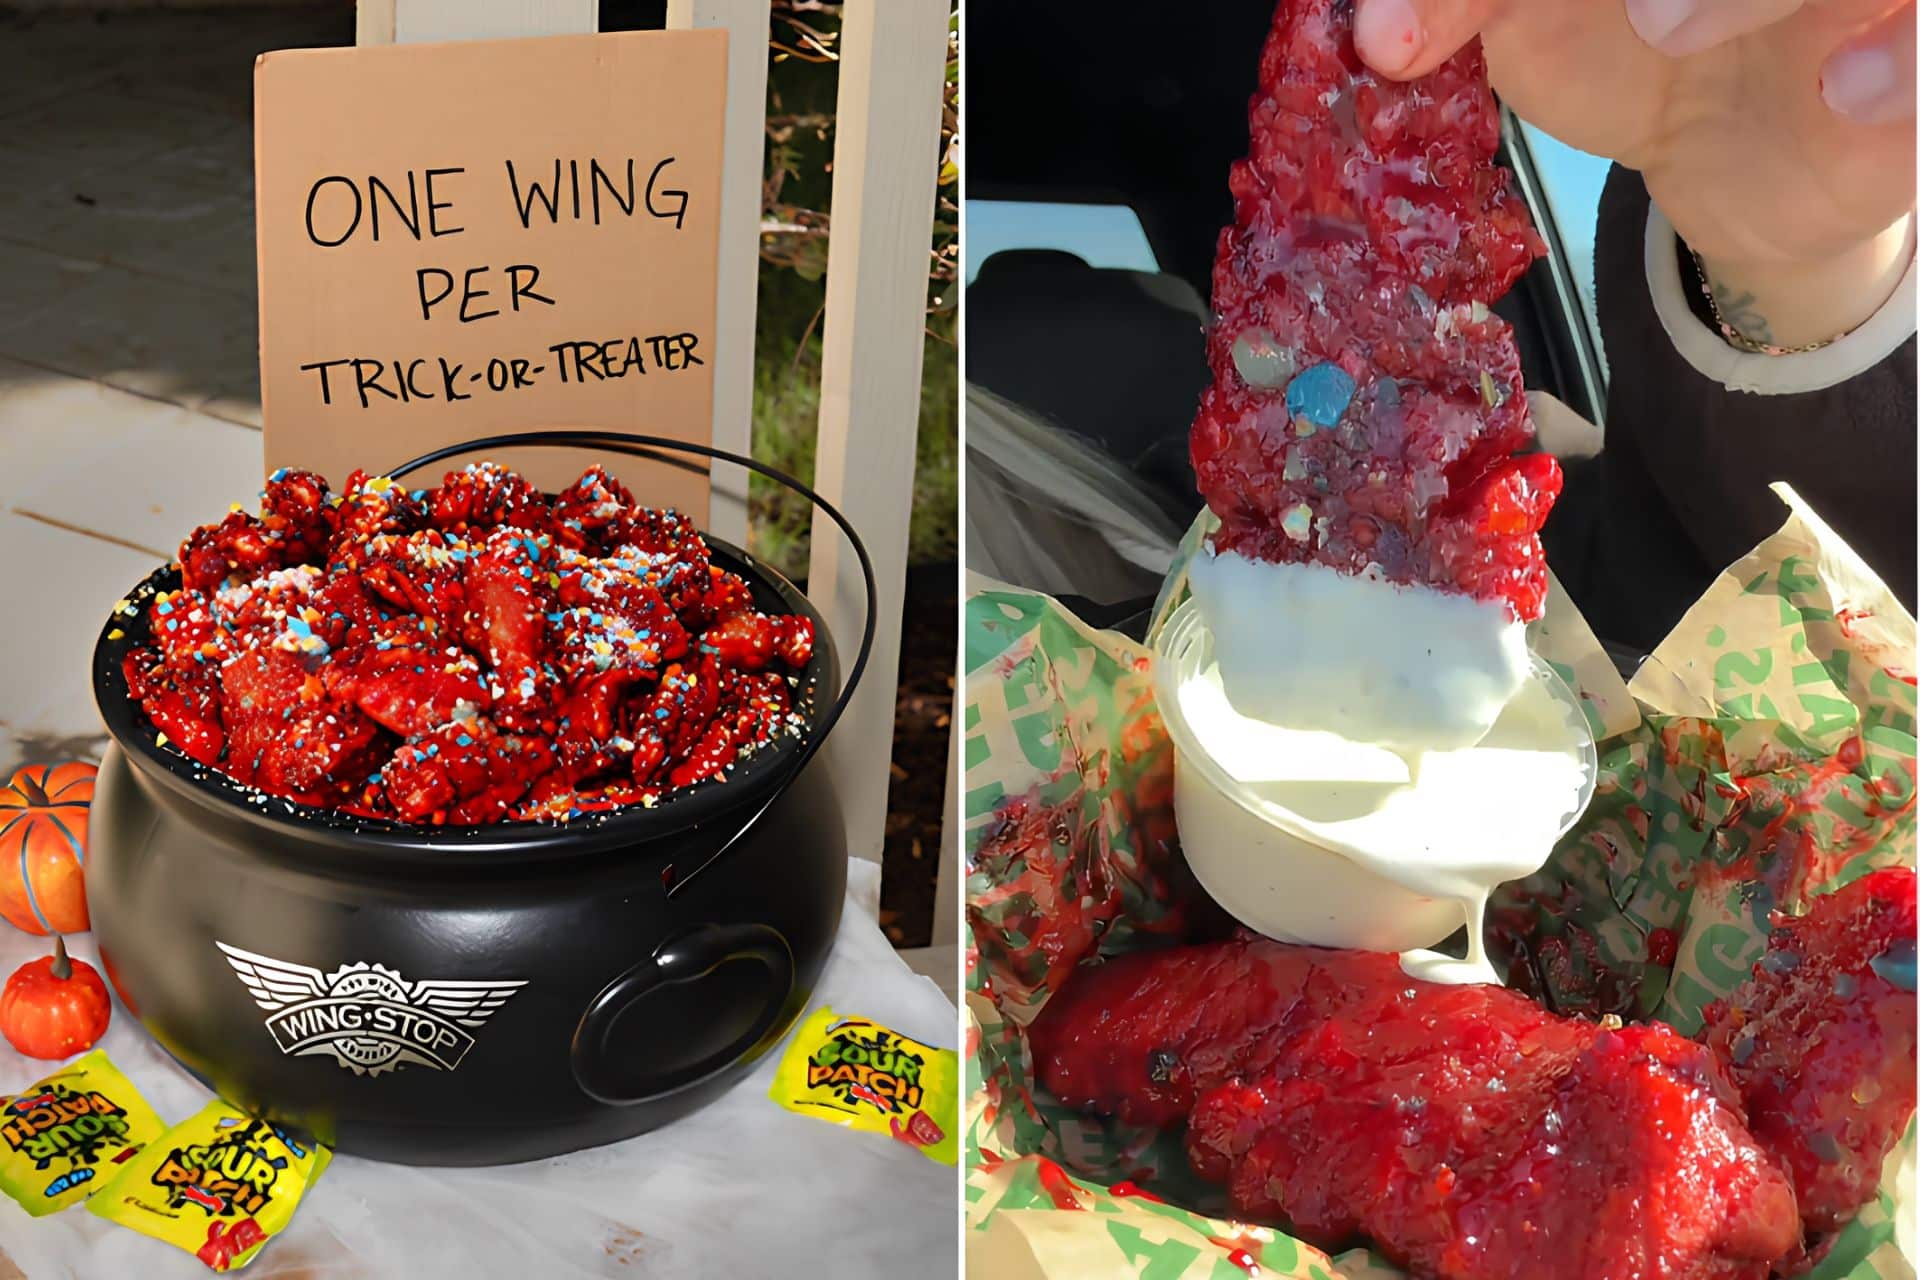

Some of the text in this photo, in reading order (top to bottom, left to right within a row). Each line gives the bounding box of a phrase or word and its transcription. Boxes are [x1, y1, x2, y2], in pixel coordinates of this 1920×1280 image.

[305, 157, 689, 247] ONE WING
[416, 264, 556, 323] PER
[300, 332, 705, 409] TRICK-OR-TREATER
[808, 1063, 921, 1109] PATCH
[813, 1040, 922, 1086] SOUR
[1, 1092, 119, 1147] PATCH
[22, 1112, 130, 1160] SOUR
[179, 1144, 278, 1195] SOUR
